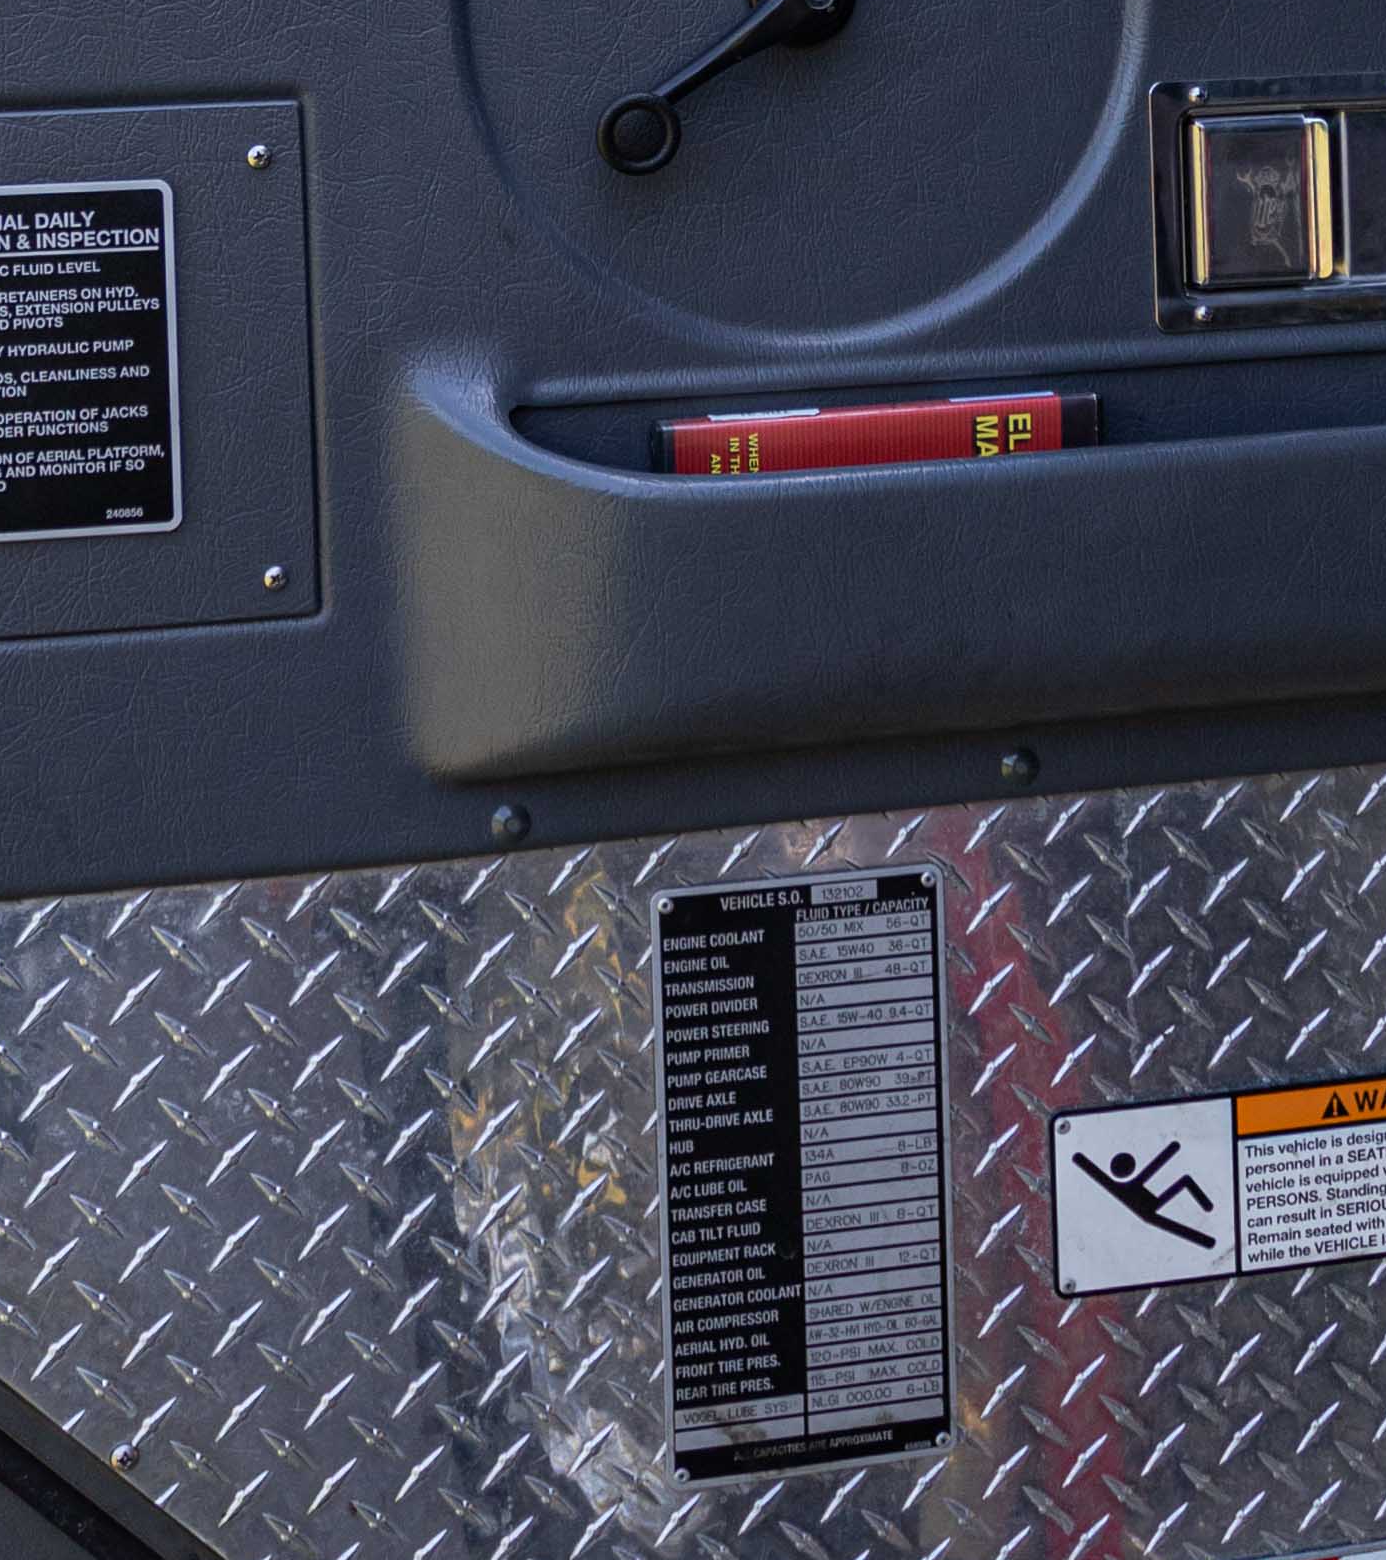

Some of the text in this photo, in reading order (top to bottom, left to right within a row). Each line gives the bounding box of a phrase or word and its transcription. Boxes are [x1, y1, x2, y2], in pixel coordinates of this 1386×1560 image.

[34, 210, 95, 230] DAILY
[16, 233, 31, 250] &
[36, 227, 160, 249] INSPECTION
[12, 262, 54, 276] FLUID
[57, 260, 101, 274] LEVEL
[80, 287, 102, 300] ON
[105, 285, 139, 299] HYD.
[15, 301, 95, 317] EXTENSION
[97, 297, 160, 313] PULLEYS
[12, 315, 64, 330] PIVOTS
[7, 341, 90, 357] HYDRAULIC
[92, 339, 134, 353] PUMP
[20, 366, 117, 384] CLEANLINESS
[119, 365, 150, 378] AND
[79, 407, 99, 421] OF
[101, 405, 149, 420] JACKS
[27, 420, 109, 437] FUNCTIONS
[15, 451, 35, 465] OF
[36, 448, 86, 463] AERIAL
[87, 444, 165, 460] PLATFORM,
[729, 437, 740, 453] IN
[5, 465, 37, 479] AND
[39, 460, 106, 477] MONITOR
[109, 459, 122, 472] IF
[125, 458, 145, 471] SO
[720, 885, 864, 911] VEHICLE S.O. 132102
[797, 912, 929, 939] 50/50 MIX 56-QT
[663, 929, 765, 952] ENGINE COOLANT
[664, 975, 755, 997] TRANSMISSION
[669, 1139, 695, 1155] HUB
[1244, 1143, 1275, 1159] This
[1277, 1136, 1328, 1156] vehicle
[1331, 1134, 1343, 1148] is
[1245, 1155, 1316, 1179] personnel
[1319, 1154, 1332, 1167] in
[1335, 1154, 1344, 1165] a
[1245, 1176, 1295, 1193] vehicle
[1299, 1174, 1311, 1187] is
[1314, 1164, 1380, 1186] equipped
[1246, 1189, 1323, 1211] PERSONS.
[1246, 1216, 1273, 1229] can
[1276, 1207, 1317, 1225] result
[1319, 1206, 1333, 1219] in
[1247, 1228, 1302, 1246] Remain
[1305, 1220, 1353, 1239] seated
[1355, 1216, 1386, 1232] with
[1247, 1247, 1285, 1263] while
[1288, 1244, 1311, 1258] the
[1314, 1233, 1378, 1255] VEHICLE
[808, 1292, 938, 1320] SHARED W/ENGINE OIL
[675, 1353, 781, 1380] FRONT TIRE PRES.
